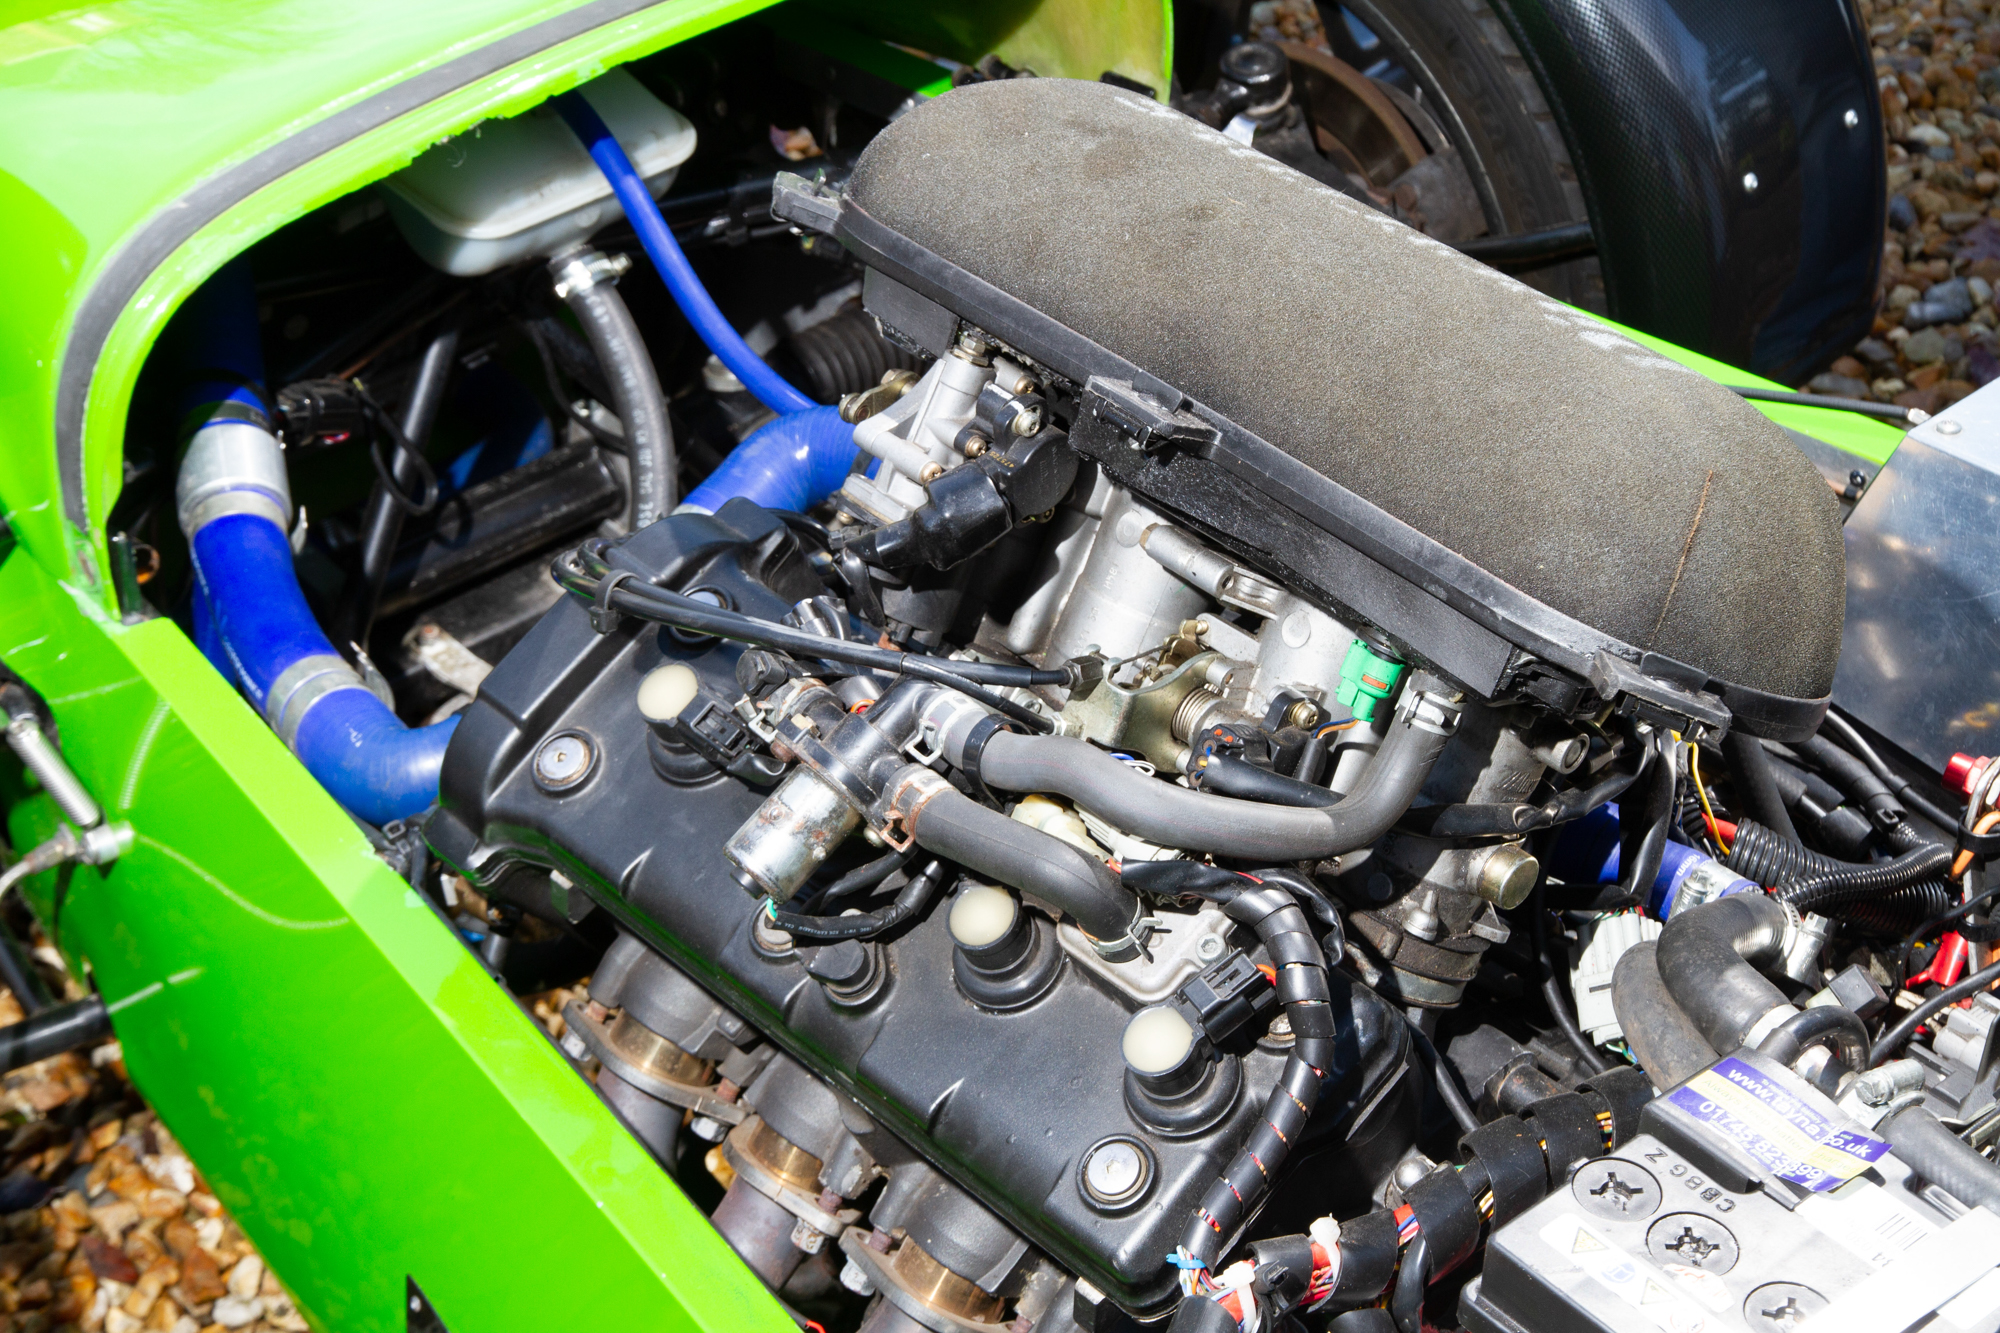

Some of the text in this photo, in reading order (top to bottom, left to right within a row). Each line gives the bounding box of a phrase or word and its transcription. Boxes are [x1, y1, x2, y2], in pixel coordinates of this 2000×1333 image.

[1676, 853, 1699, 876] 16mm
[1698, 1100, 1758, 1141] 01745
[1701, 1079, 1741, 1106] Always
[1742, 1104, 1771, 1125] keep
[1770, 1124, 1808, 1154] batter
